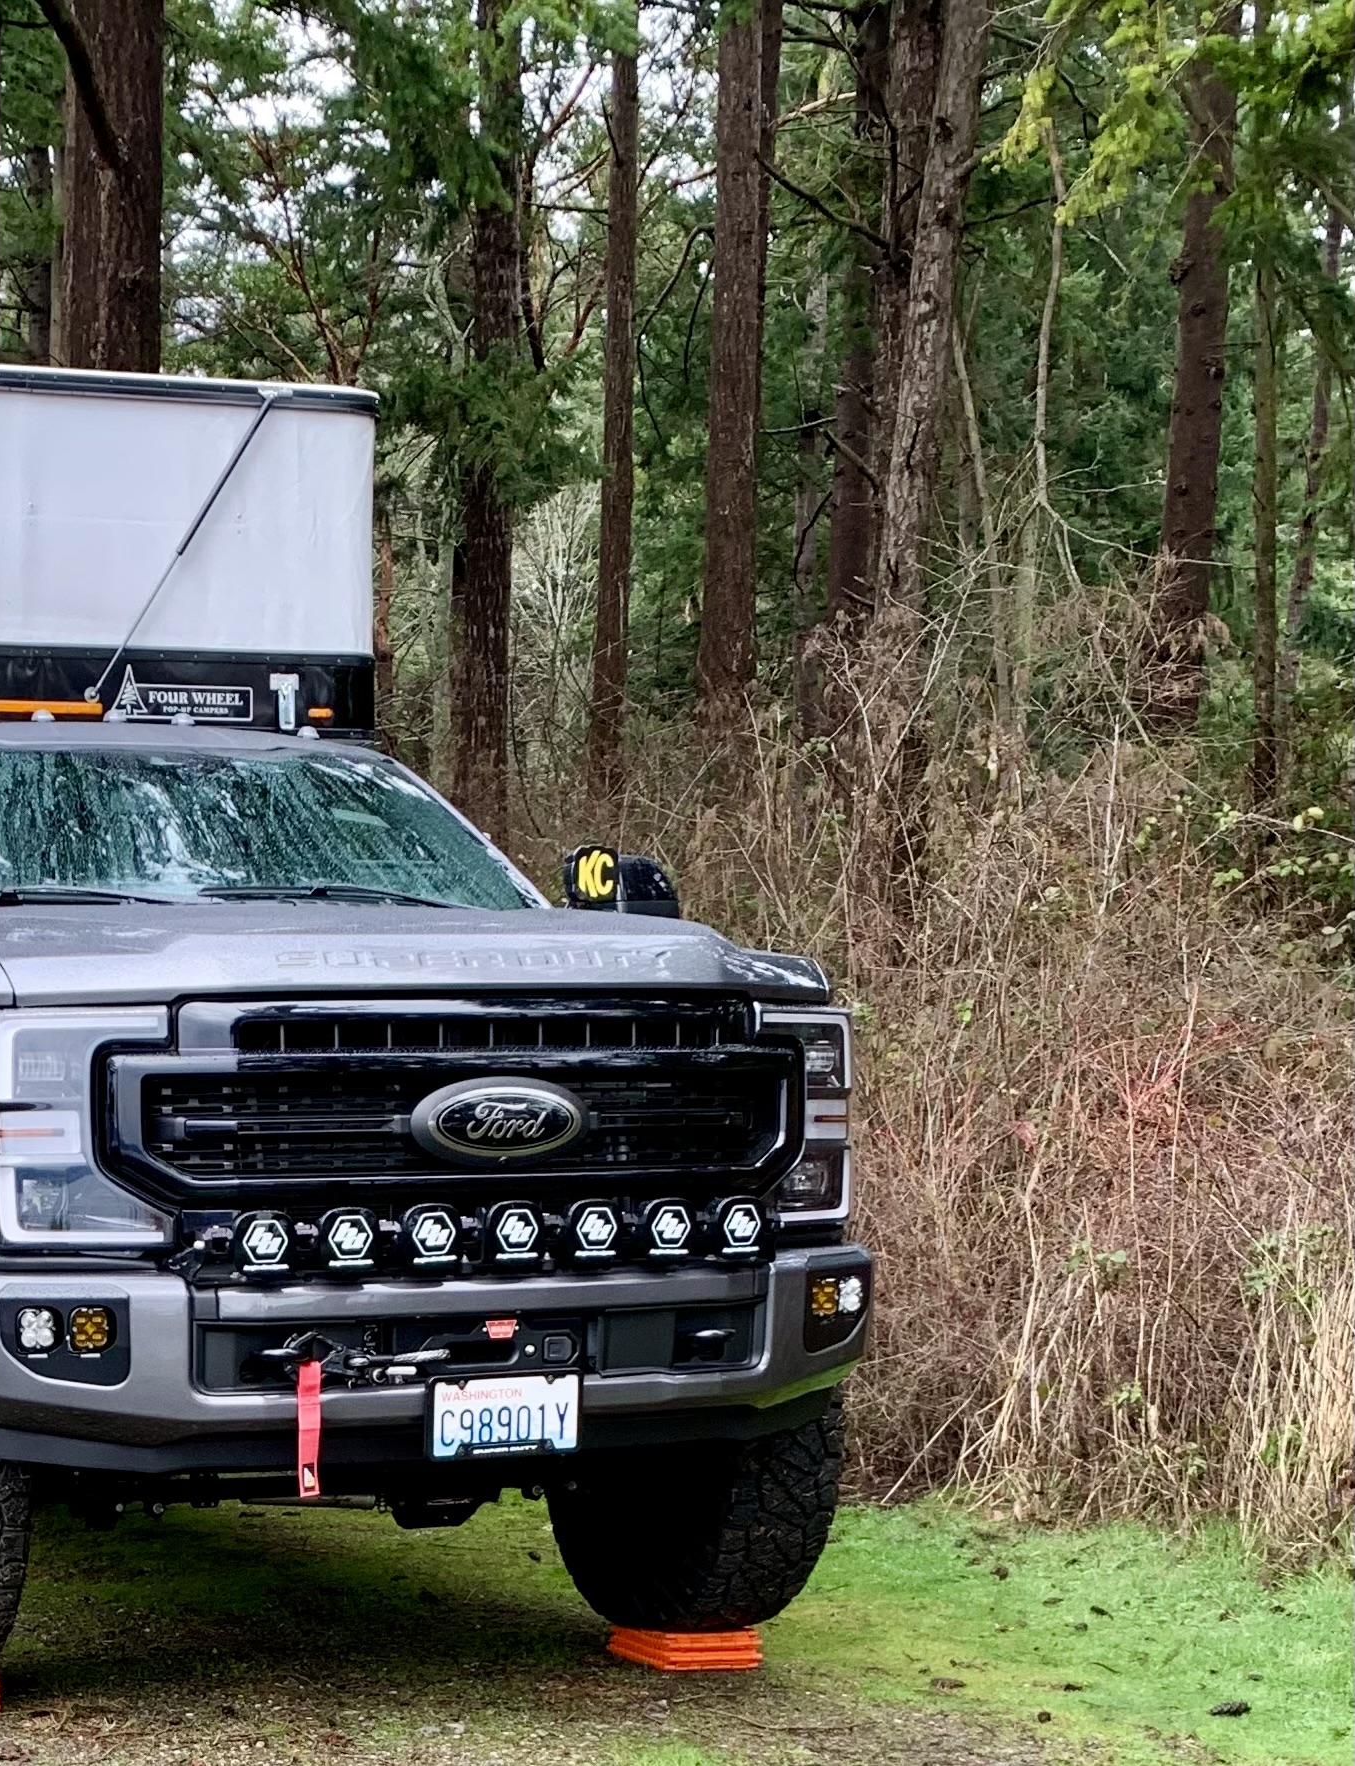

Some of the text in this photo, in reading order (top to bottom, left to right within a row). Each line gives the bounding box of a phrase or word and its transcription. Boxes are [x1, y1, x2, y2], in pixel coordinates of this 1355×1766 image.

[148, 690, 244, 706] FOUR WHEEL
[162, 705, 229, 715] POP-UP CAMPERS
[578, 850, 615, 898] KC
[466, 1101, 547, 1140] Ford
[442, 1388, 522, 1402] WASHINGTON
[441, 1402, 568, 1446] C98901Y
